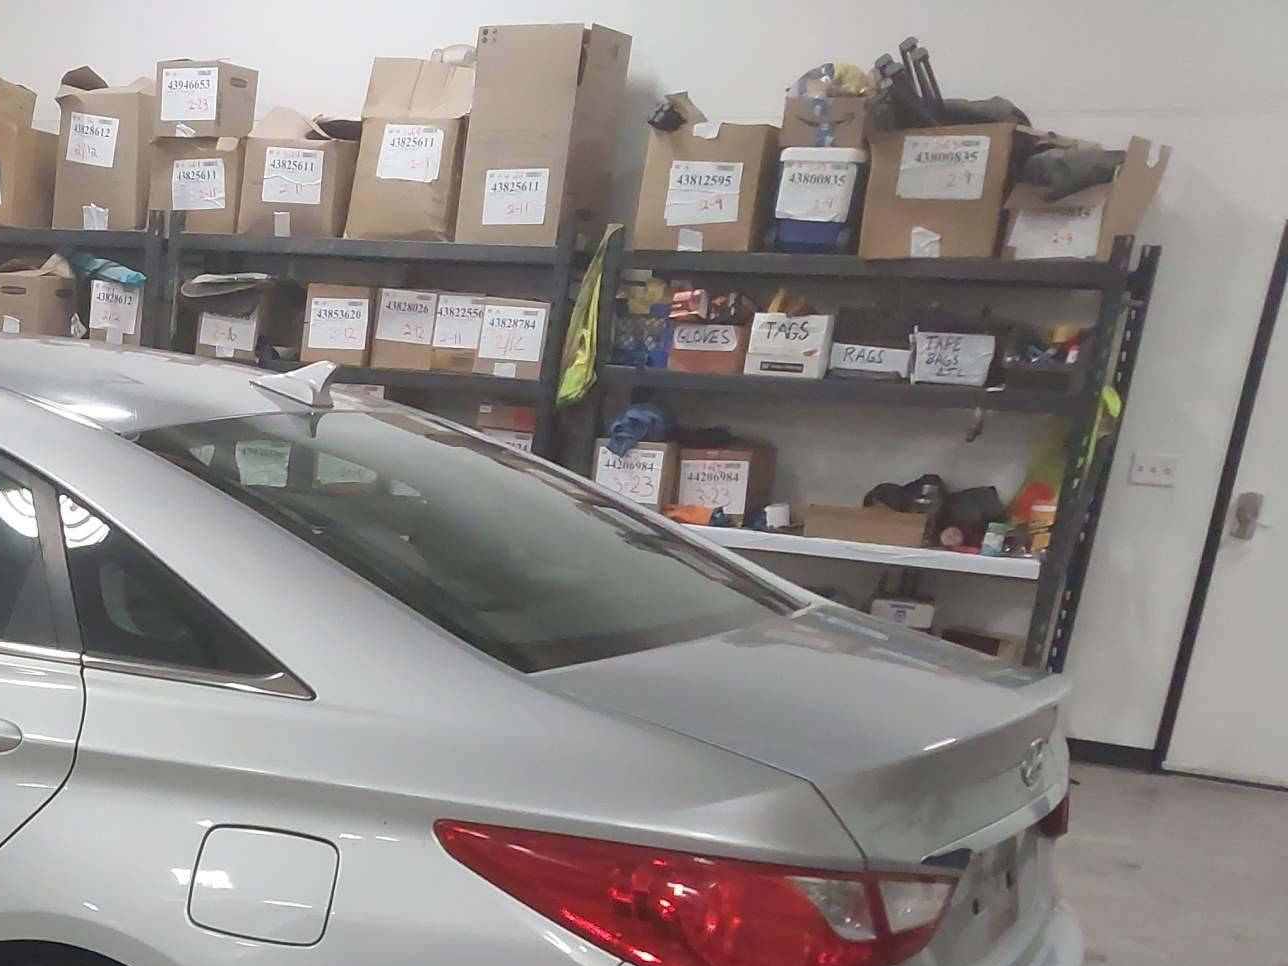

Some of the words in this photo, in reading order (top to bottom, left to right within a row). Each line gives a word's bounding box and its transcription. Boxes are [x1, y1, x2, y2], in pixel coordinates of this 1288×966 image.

[167, 79, 210, 90] 43946653
[389, 137, 435, 148] 43825611
[270, 159, 314, 172] 43825611
[176, 169, 216, 181] 43825611
[676, 173, 732, 187] 43812595
[788, 172, 846, 185] 43800835
[491, 181, 539, 192] 43825611
[316, 309, 362, 320] 43853620
[385, 301, 430, 315] 43828026
[489, 317, 537, 330] 43828784
[676, 329, 731, 345] GLOVES
[765, 320, 810, 341] TAGS
[925, 334, 963, 352] TAPE
[842, 346, 885, 364] RAGS
[925, 352, 960, 367] BAGS
[604, 458, 657, 473] 44206984
[687, 471, 740, 483] 44206984
